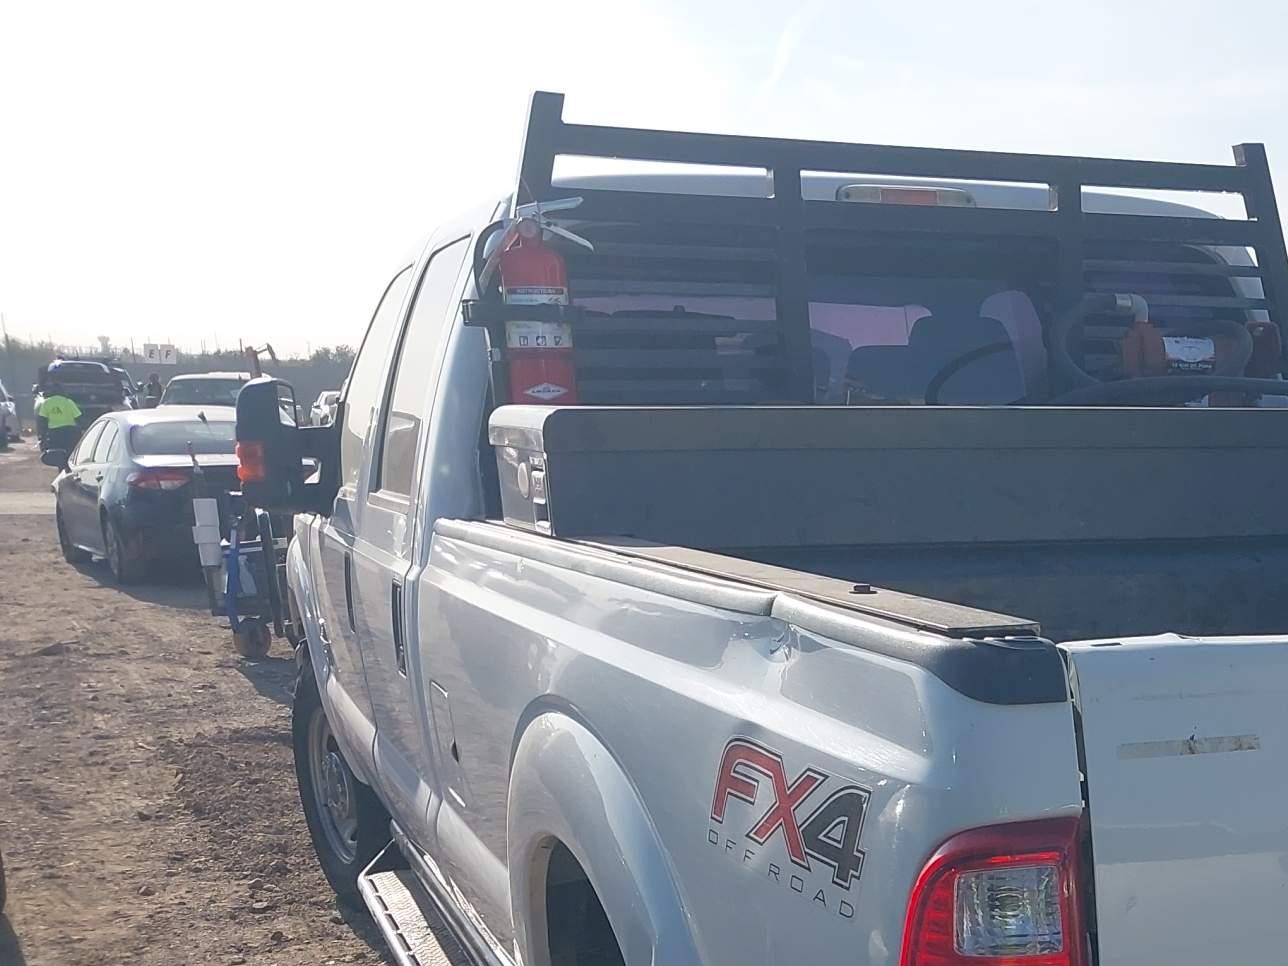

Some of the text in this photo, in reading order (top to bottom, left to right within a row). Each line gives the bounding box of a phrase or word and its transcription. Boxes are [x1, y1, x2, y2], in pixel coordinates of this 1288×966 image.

[707, 828, 855, 919] OFF ROAD
[710, 735, 873, 890] FX4
